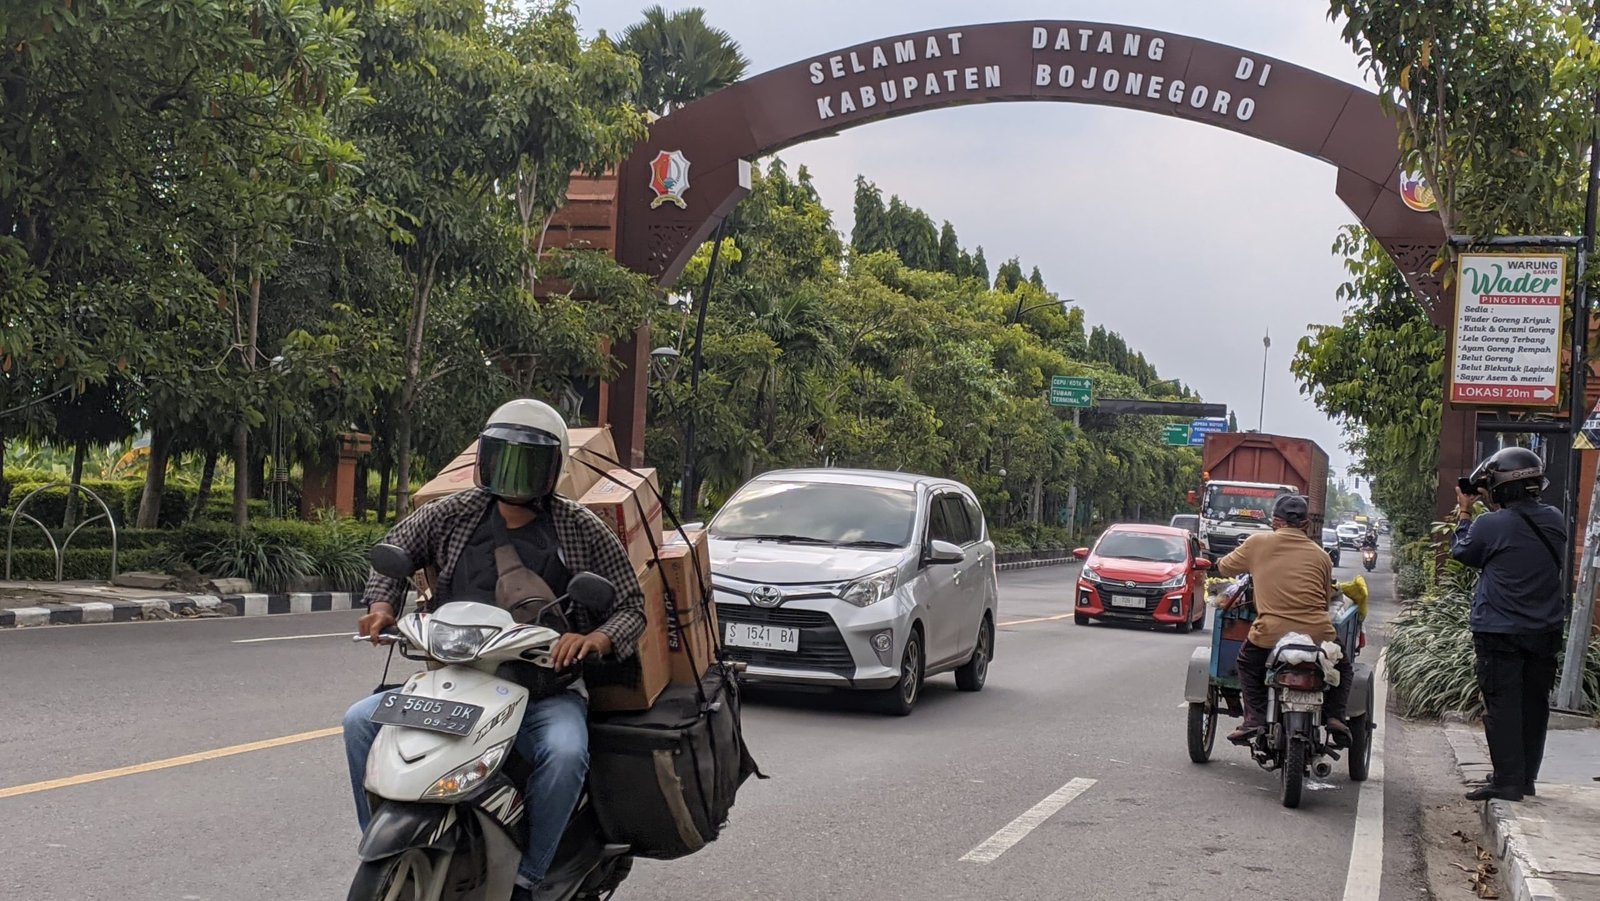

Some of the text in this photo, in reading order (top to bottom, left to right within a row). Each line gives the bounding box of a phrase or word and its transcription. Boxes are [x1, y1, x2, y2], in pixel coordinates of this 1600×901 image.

[809, 26, 1272, 87] SELAMAT DATANG DI
[816, 64, 1256, 121] KABUPATEN BOJONEGORO
[1508, 261, 1558, 270] WARUNG
[1463, 263, 1558, 295] Wader
[1482, 296, 1529, 304] PINGGIR
[1492, 317, 1520, 325] Goreng
[1523, 317, 1551, 325] Kriyuk
[1529, 327, 1555, 335] Goreng
[1481, 336, 1509, 344] Goreng
[1512, 336, 1546, 344] Terbang
[1461, 345, 1551, 354] Ayam Goreng Rempah
[1485, 355, 1513, 363] Goreng
[1484, 364, 1522, 372] Blekutuk
[1460, 374, 1484, 382] Sayur
[1459, 387, 1530, 398] LOKASI 20m
[730, 625, 794, 643] S 1541 BA
[384, 695, 475, 720] S 5605 DK
[423, 717, 466, 731] 09-27
